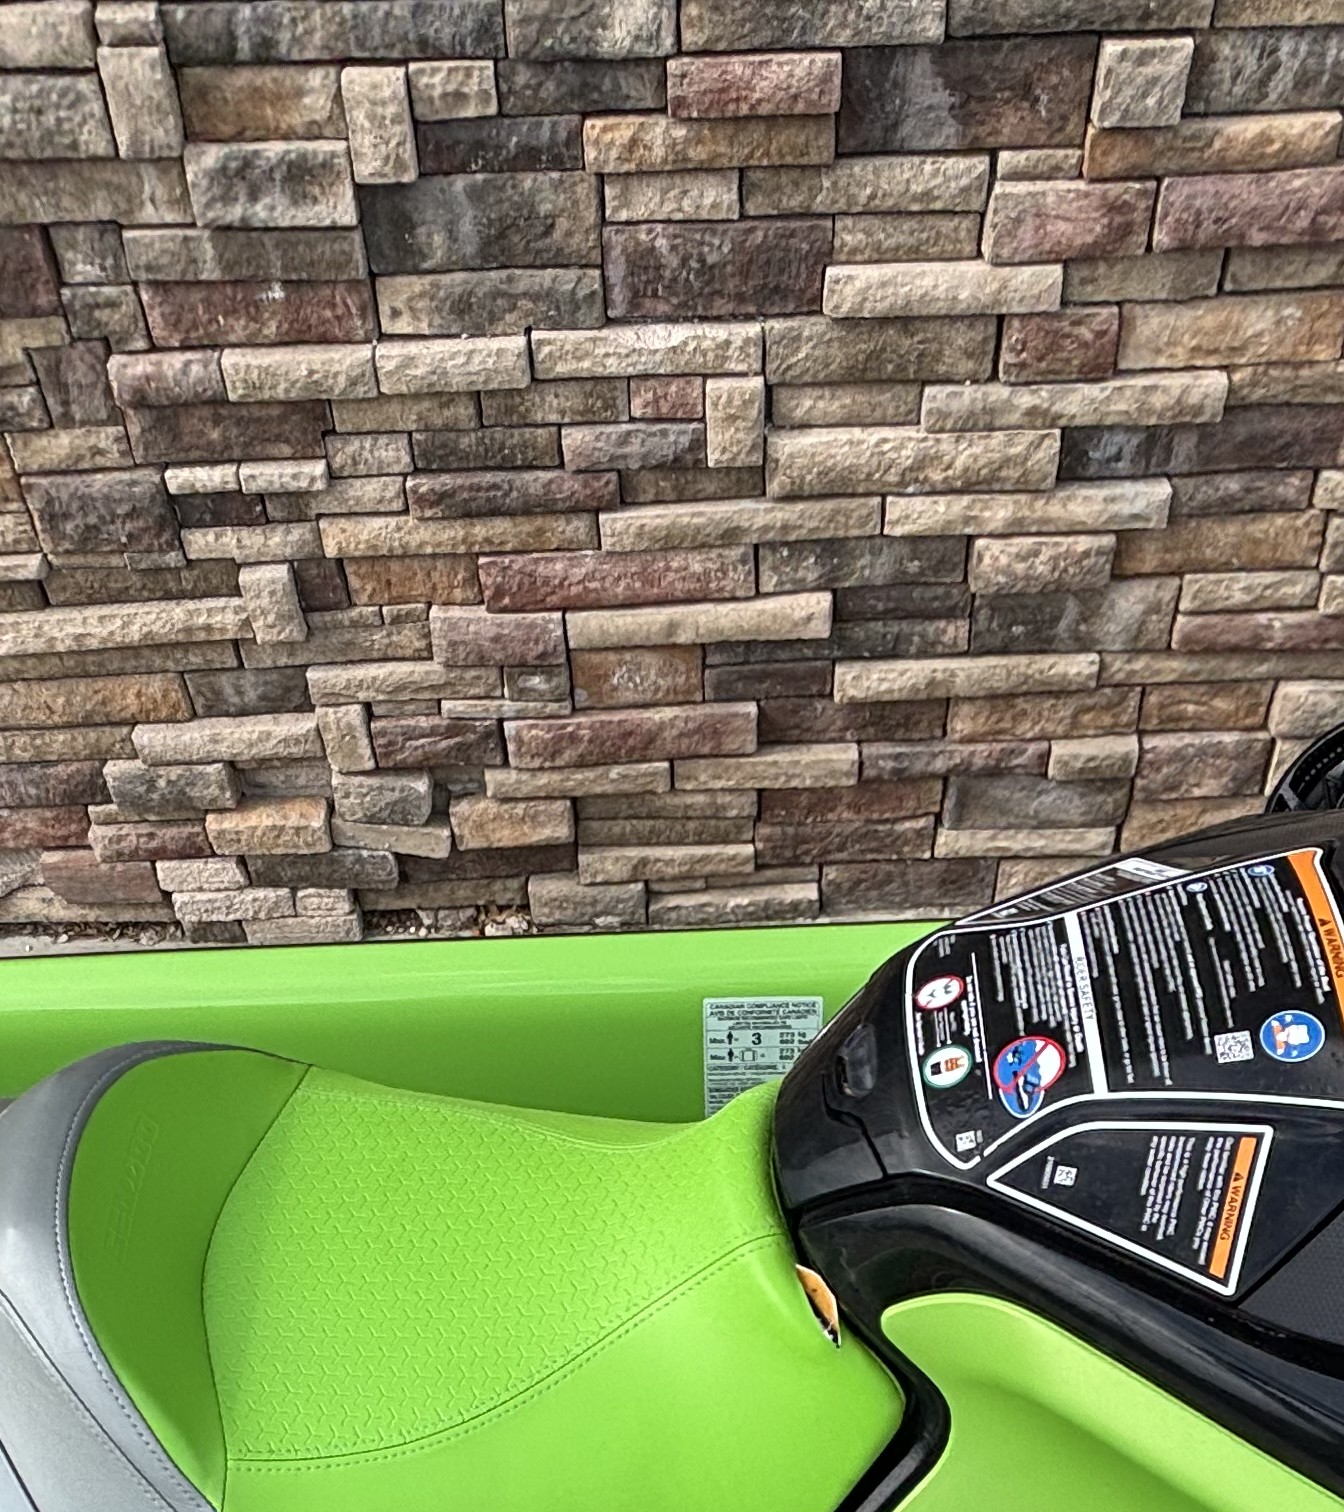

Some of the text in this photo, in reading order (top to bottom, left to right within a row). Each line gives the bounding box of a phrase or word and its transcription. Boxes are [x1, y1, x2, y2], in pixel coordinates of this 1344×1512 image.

[1079, 984, 1095, 1021] SAFETY
[752, 1032, 762, 1045] 3
[1219, 1185, 1242, 1241] WARNING
